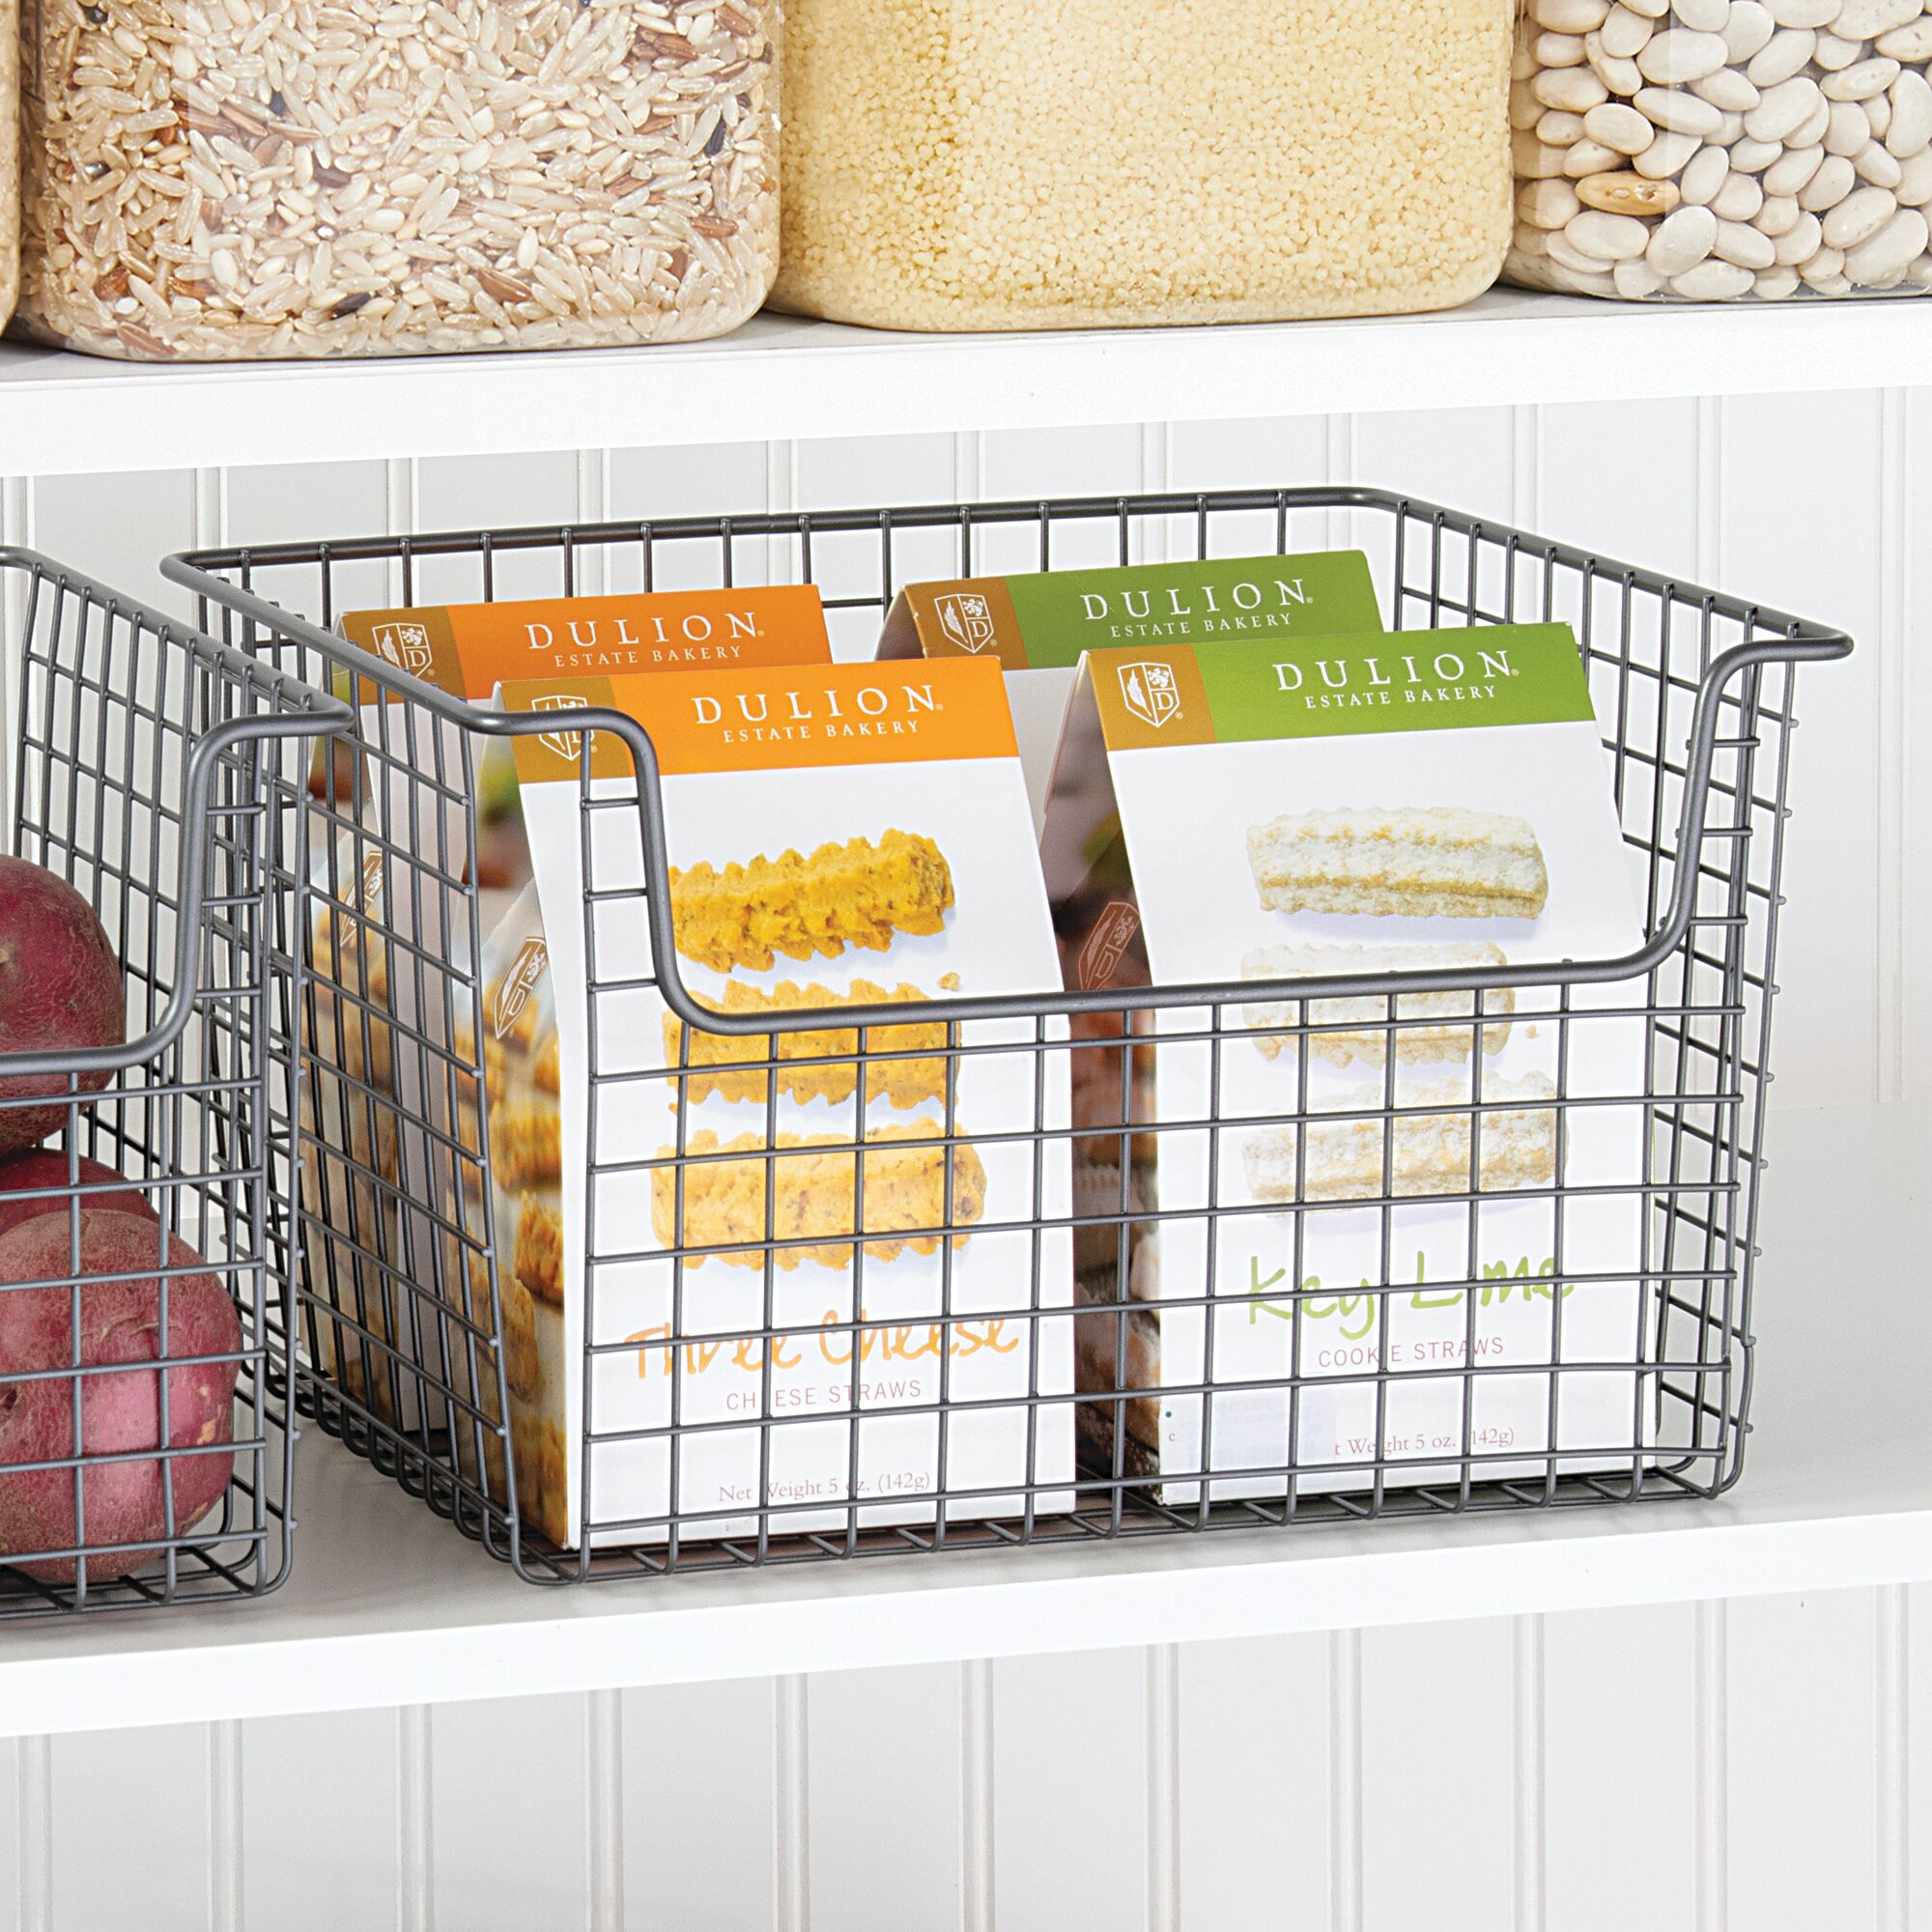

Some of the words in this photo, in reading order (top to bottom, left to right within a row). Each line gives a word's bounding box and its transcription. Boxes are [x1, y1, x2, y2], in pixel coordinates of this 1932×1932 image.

[1079, 579, 1306, 620] DULION
[524, 611, 757, 650] DULION
[1110, 621, 1191, 639] ESTATE
[1203, 612, 1292, 633] BAKERY
[554, 651, 639, 668] ESTATE
[652, 645, 742, 663] BAKERY
[1271, 650, 1512, 691] DULION
[691, 684, 936, 724] DULION
[1304, 692, 1391, 709] ESTATE
[1404, 685, 1496, 703] BAKERY
[723, 725, 811, 743] ESTATE
[826, 720, 919, 738] BAKERY
[1249, 1255, 1375, 1340] Key
[1410, 1250, 1575, 1309] Lme
[624, 1321, 803, 1379] Three
[819, 1309, 1020, 1366] Cheese
[1319, 1345, 1403, 1368] COOKE
[725, 1387, 817, 1410] CHESE
[1347, 1435, 1409, 1456] Weght
[1415, 1435, 1425, 1449] 5
[1432, 1436, 1457, 1449] oz.
[1463, 1426, 1515, 1448] 142g)
[719, 1487, 752, 1501] Net
[828, 1478, 838, 1493] 5
[878, 1471, 930, 1493] (142g)
